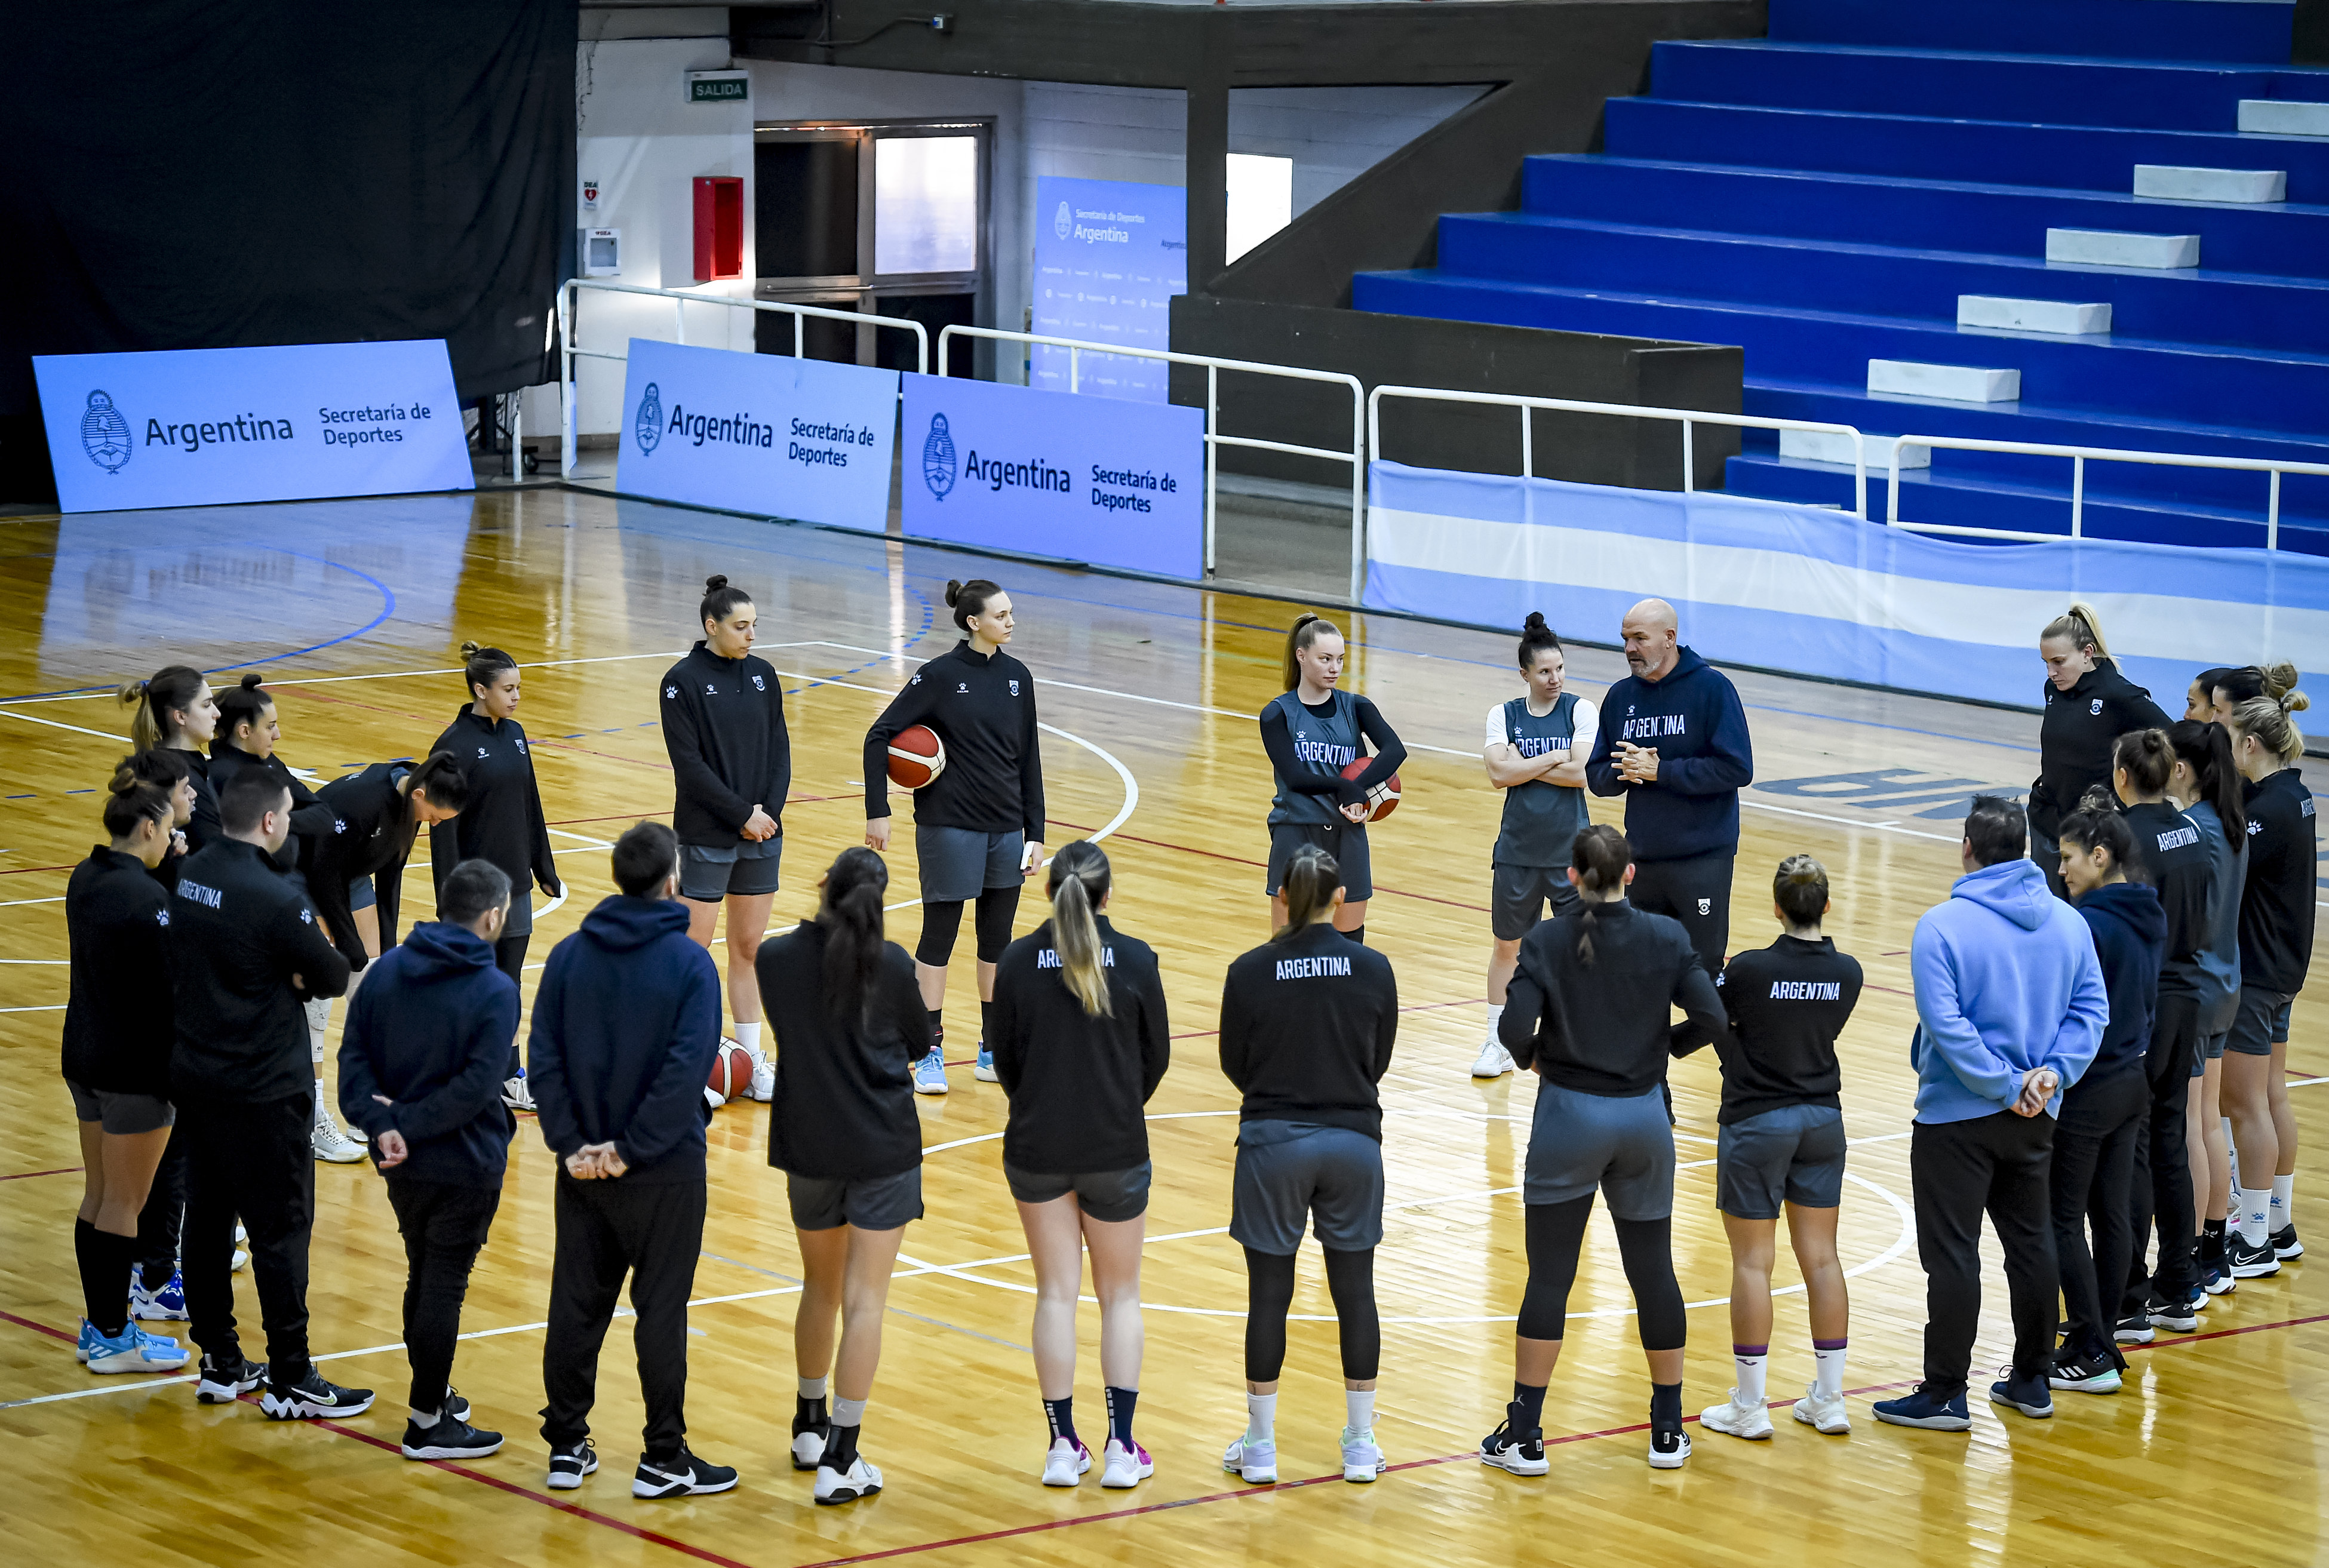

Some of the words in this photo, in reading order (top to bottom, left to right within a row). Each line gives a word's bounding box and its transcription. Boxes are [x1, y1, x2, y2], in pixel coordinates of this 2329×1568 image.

[696, 84, 742, 96] SALIDA
[1074, 224, 1129, 244] Argentina
[318, 403, 406, 423] Secretaría
[410, 402, 431, 419] de
[146, 413, 294, 452] Argentina
[323, 426, 403, 448] Deportes
[668, 404, 773, 448] Argentina
[790, 417, 855, 444] Secretaría
[858, 426, 874, 447] de
[788, 442, 847, 467] Deportes
[964, 450, 1071, 492] Argentina
[1092, 463, 1157, 490] Secretaría
[1160, 472, 1176, 492] de
[1092, 488, 1151, 512] Deportes
[1623, 714, 1685, 740] ARGENINA
[1294, 741, 1356, 765] ARGENTINA
[1515, 737, 1571, 757] RGENTIN
[2156, 826, 2199, 852] ARGENTINA
[1276, 957, 1351, 980] ARGENTINA
[1769, 981, 1841, 1001] ARGENTINA
